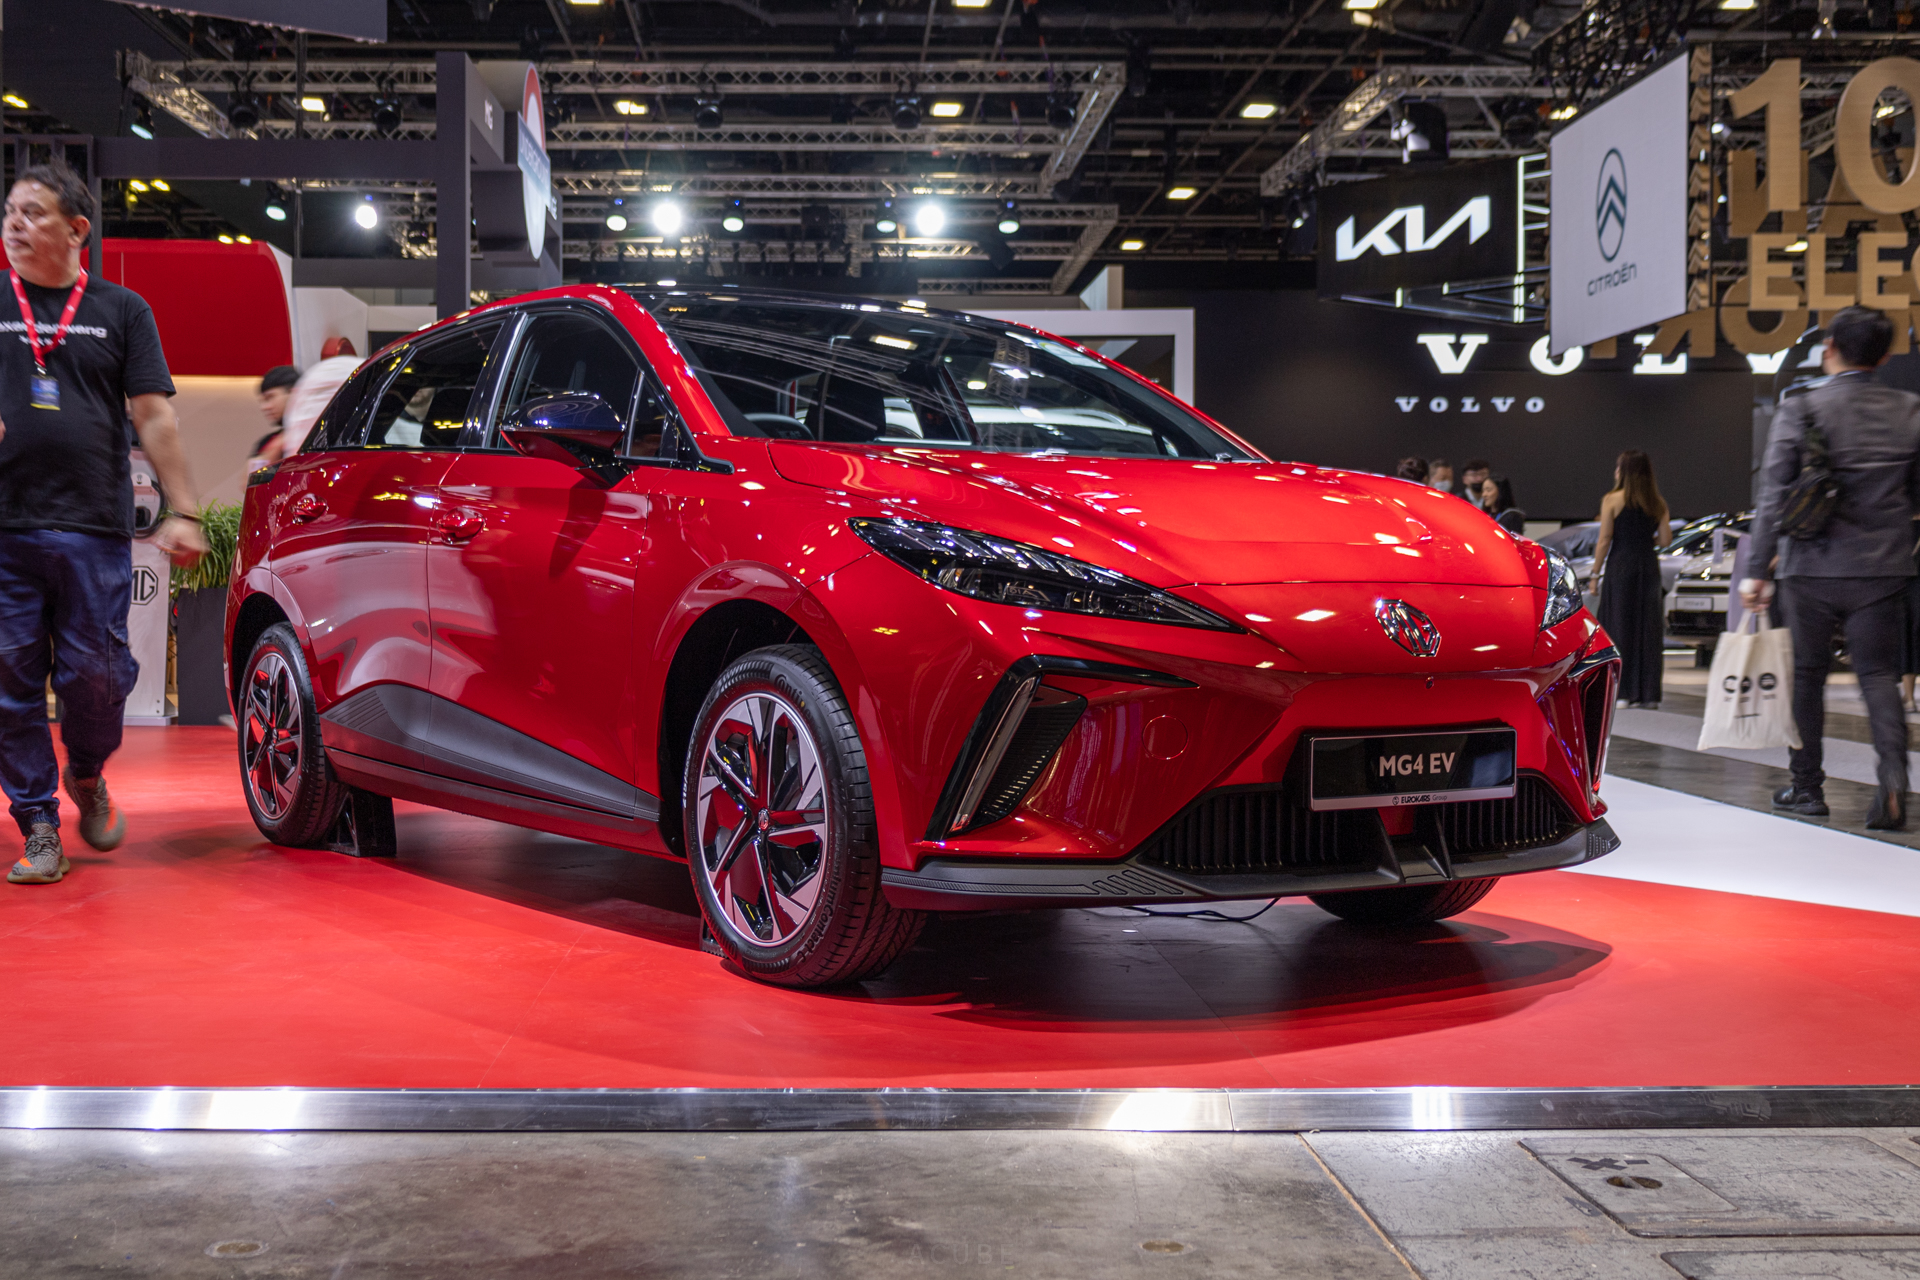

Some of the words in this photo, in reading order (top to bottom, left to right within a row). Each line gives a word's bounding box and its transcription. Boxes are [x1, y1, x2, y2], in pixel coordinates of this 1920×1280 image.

[1336, 195, 1490, 262] KIA
[1749, 233, 1920, 311] ELE
[1394, 396, 1546, 413] VOLVO
[1377, 600, 1440, 656] MG
[1379, 753, 1423, 777] MG4
[1429, 752, 1456, 774] EV
[1401, 794, 1431, 804] EUROKARS
[1432, 794, 1448, 802] Group
